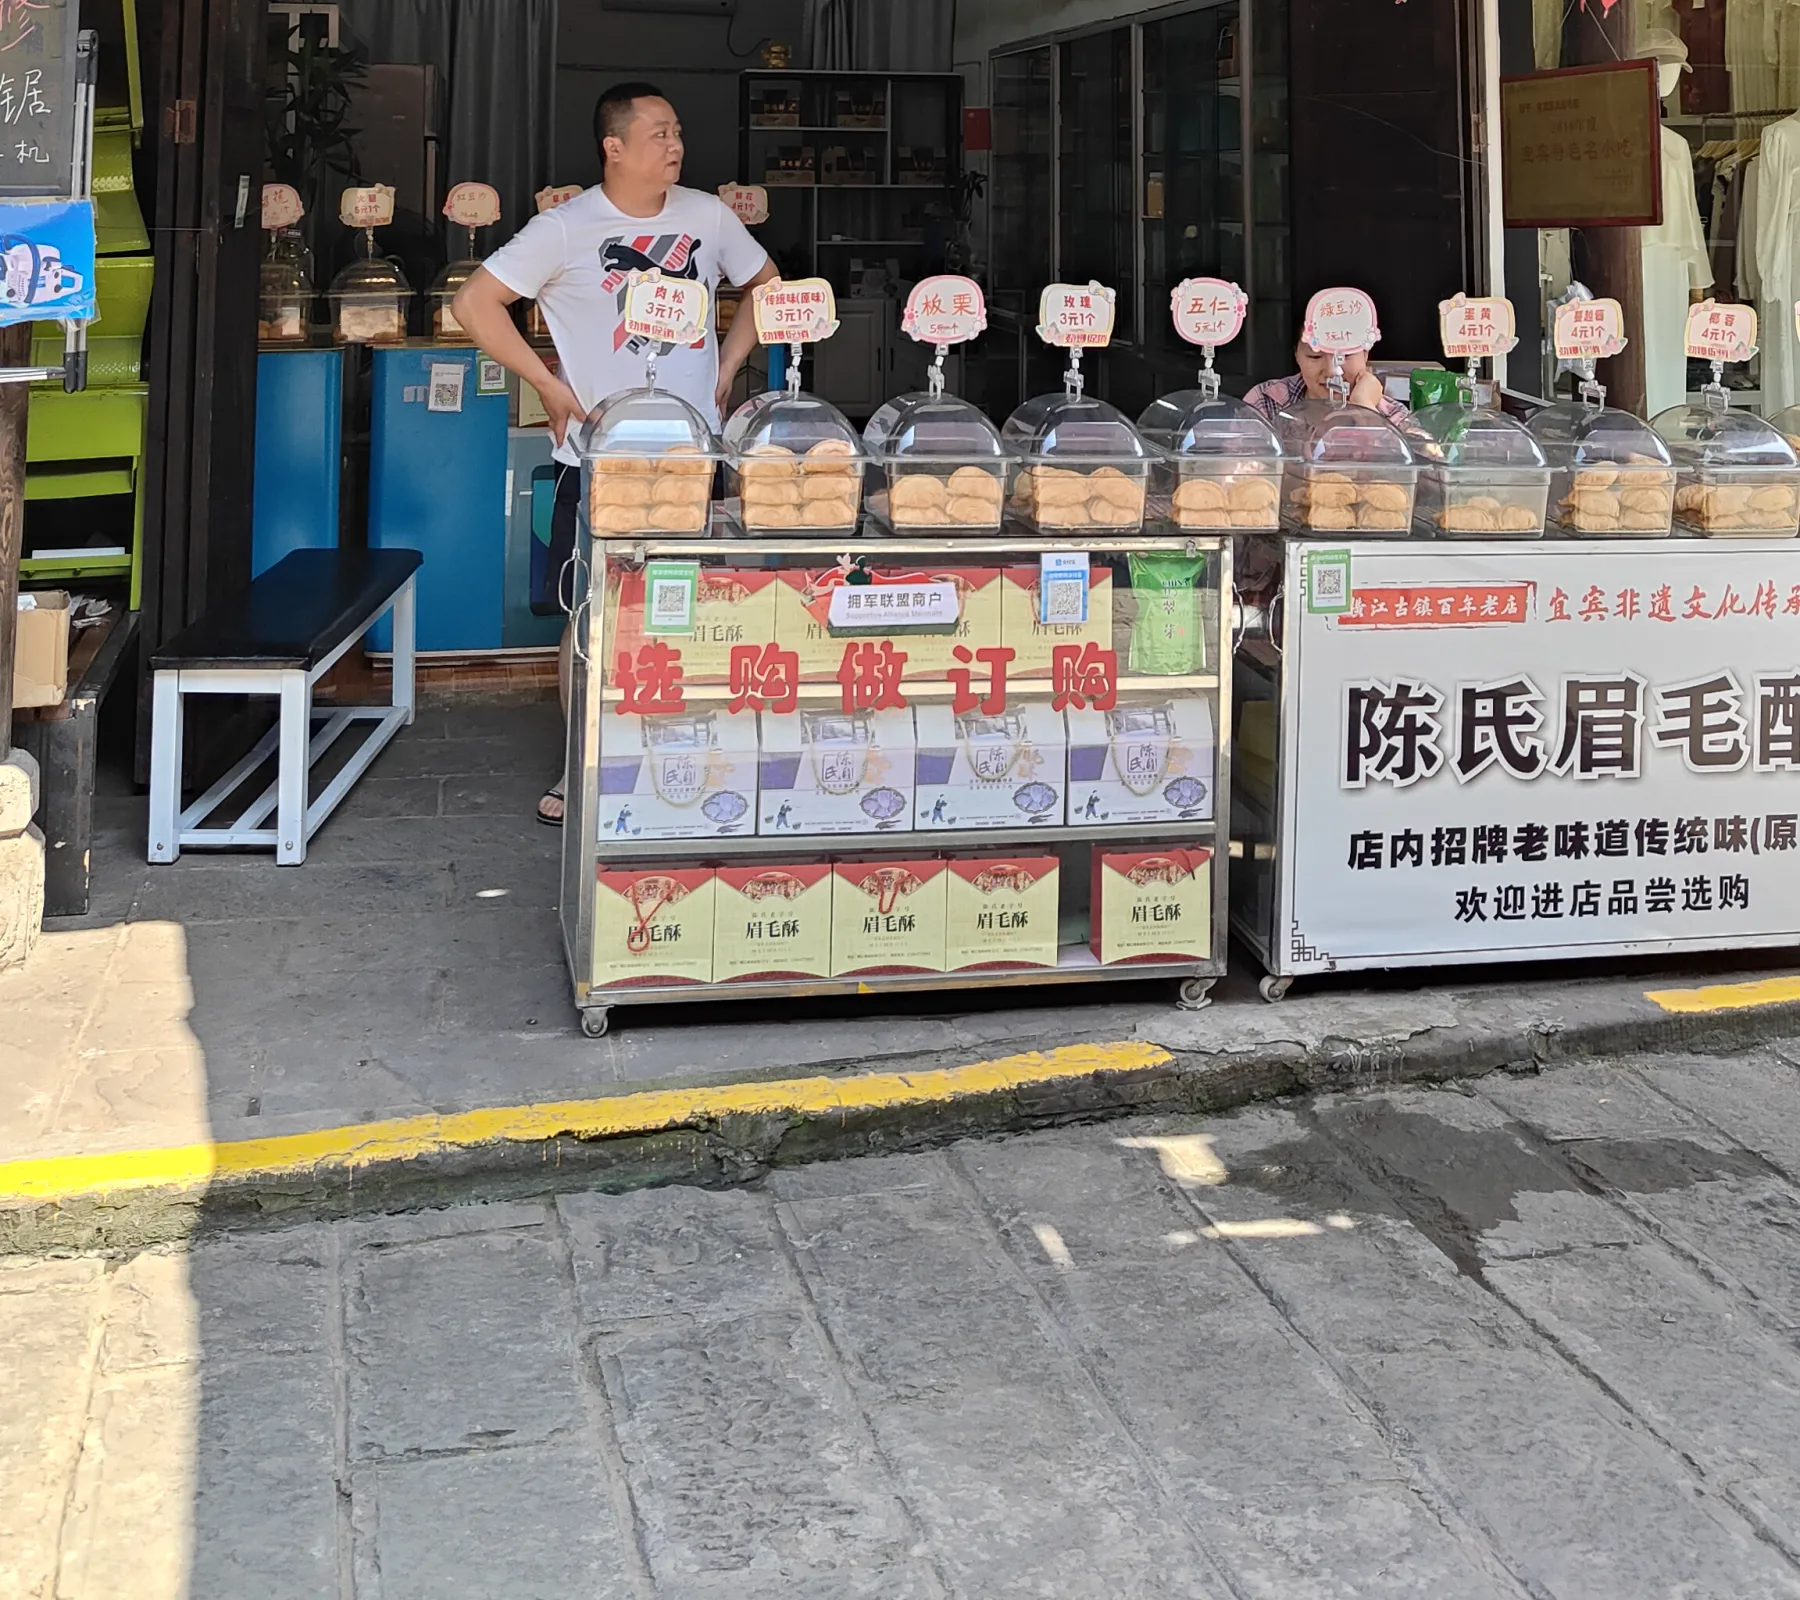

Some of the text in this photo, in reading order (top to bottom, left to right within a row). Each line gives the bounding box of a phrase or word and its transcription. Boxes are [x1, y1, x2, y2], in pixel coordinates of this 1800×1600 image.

[654, 285, 685, 305] 肉松
[921, 293, 977, 316] 板栗
[1063, 295, 1092, 309] 玫瑰
[1186, 297, 1230, 315] 五仁
[1319, 300, 1363, 317] 绿豆沙
[1464, 307, 1492, 321] 蛋黄
[847, 591, 942, 609] 拥军联盟商户
[1350, 593, 1519, 619] 横江古镇百年老店
[614, 640, 1118, 716] 选购做订购
[1453, 873, 1751, 923] 欢迎进店品尝选购
[976, 910, 1029, 930] 眉毛酥
[1131, 903, 1182, 923] 眉毛酥
[745, 918, 800, 940] 眉毛酥
[862, 913, 917, 934] 眉毛酥
